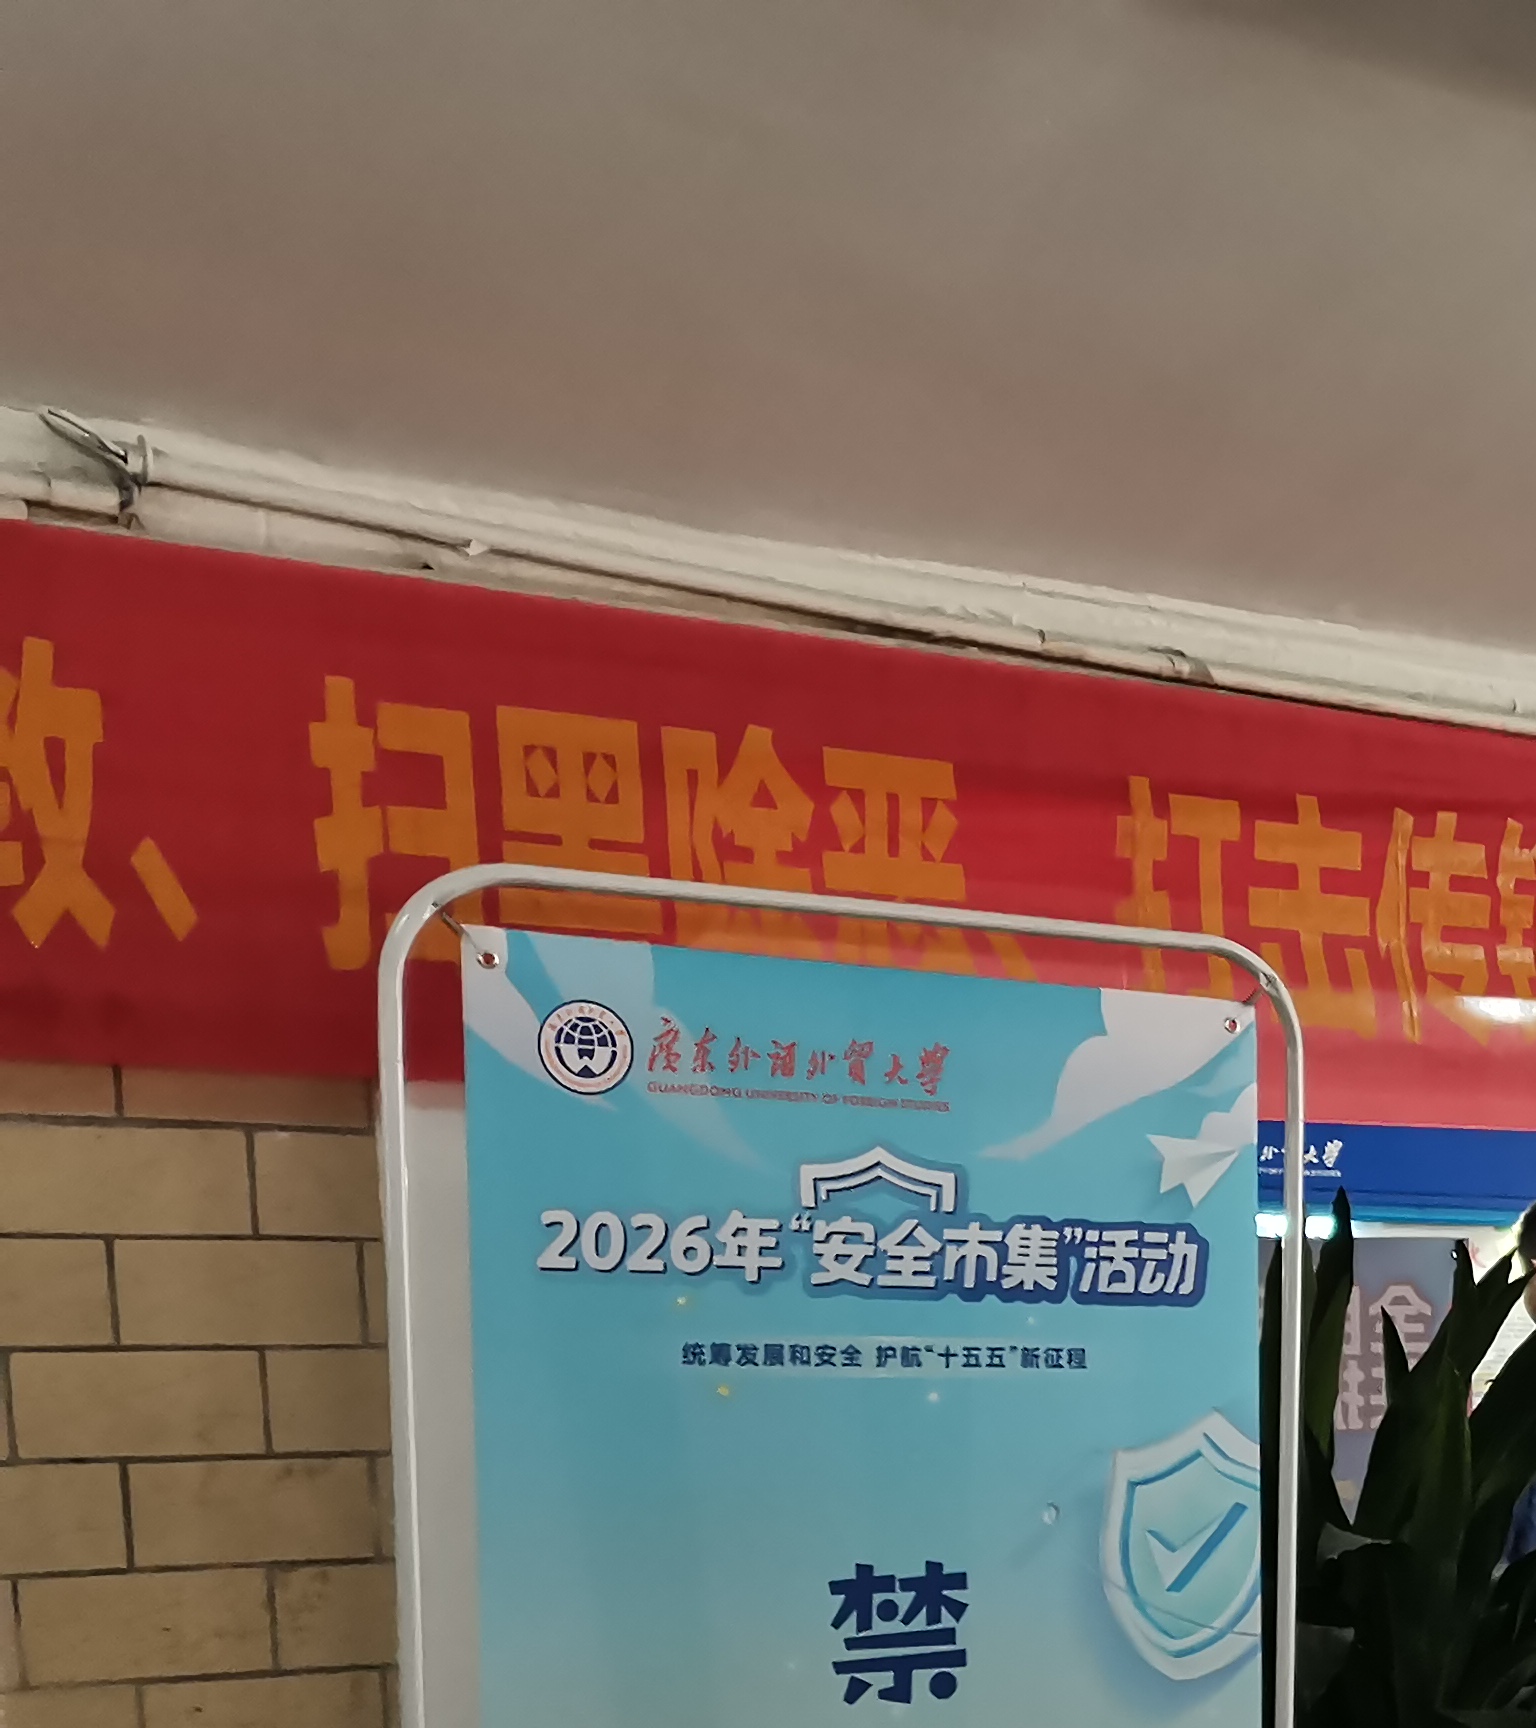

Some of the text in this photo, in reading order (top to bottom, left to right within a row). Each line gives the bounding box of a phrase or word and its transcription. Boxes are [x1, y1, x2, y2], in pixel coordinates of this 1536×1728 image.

[680, 1341, 1088, 1371] 统筹发展和安全 护航“十五五”新征程
